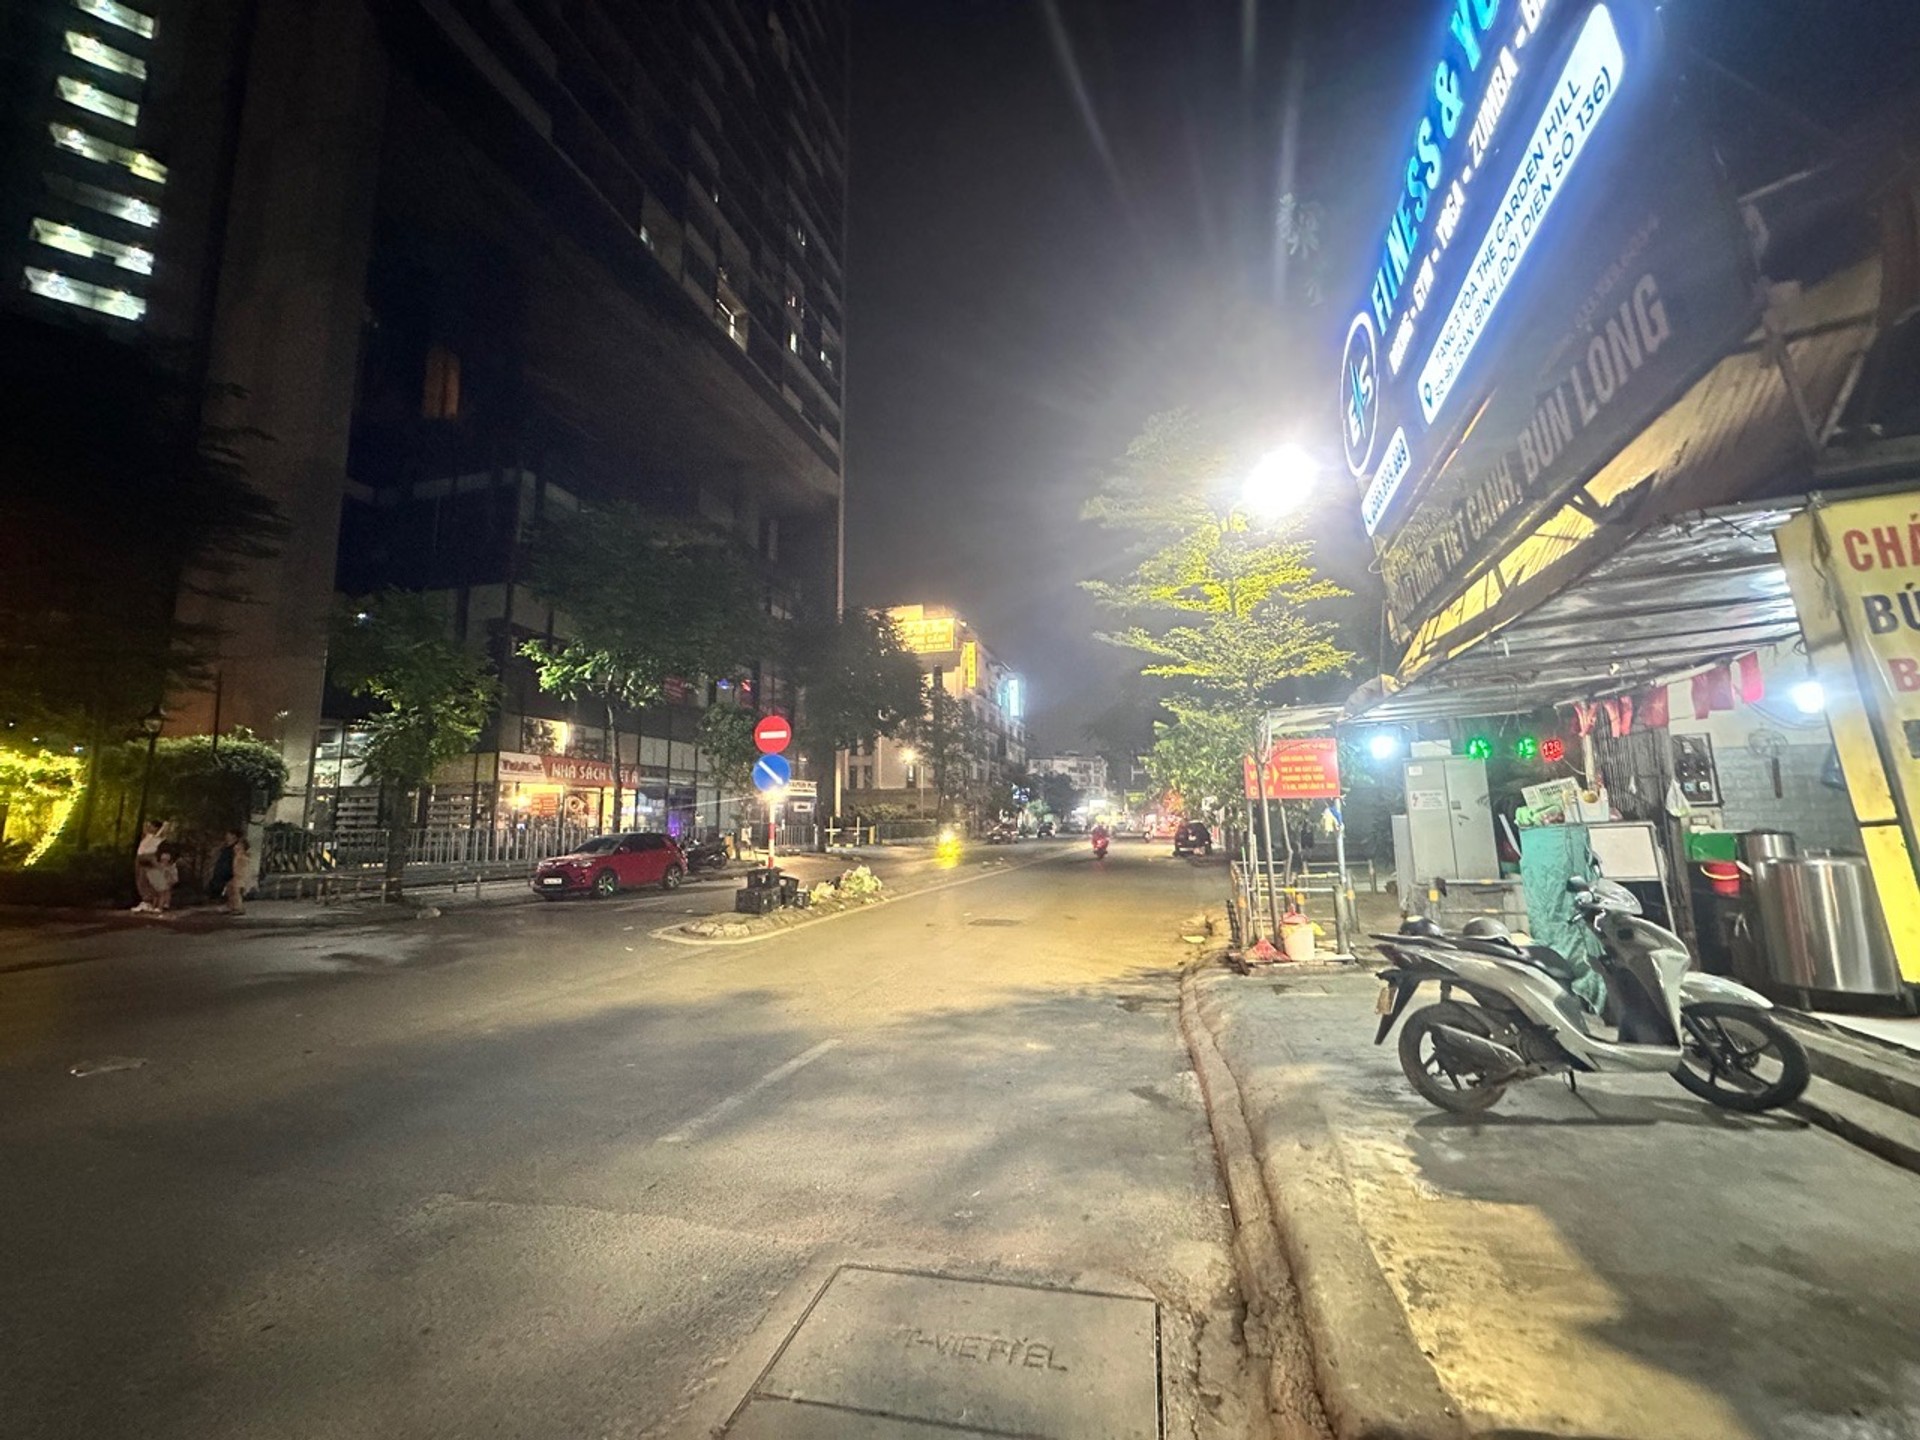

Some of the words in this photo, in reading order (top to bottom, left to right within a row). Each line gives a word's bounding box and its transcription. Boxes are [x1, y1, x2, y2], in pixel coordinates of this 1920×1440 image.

[1435, 60, 1463, 139] &
[1576, 66, 1612, 132] 136)
[1475, 239, 1496, 281] THE
[1496, 142, 1544, 243] GARDEN
[1545, 80, 1580, 145] HILL
[579, 762, 606, 780] SÁCH
